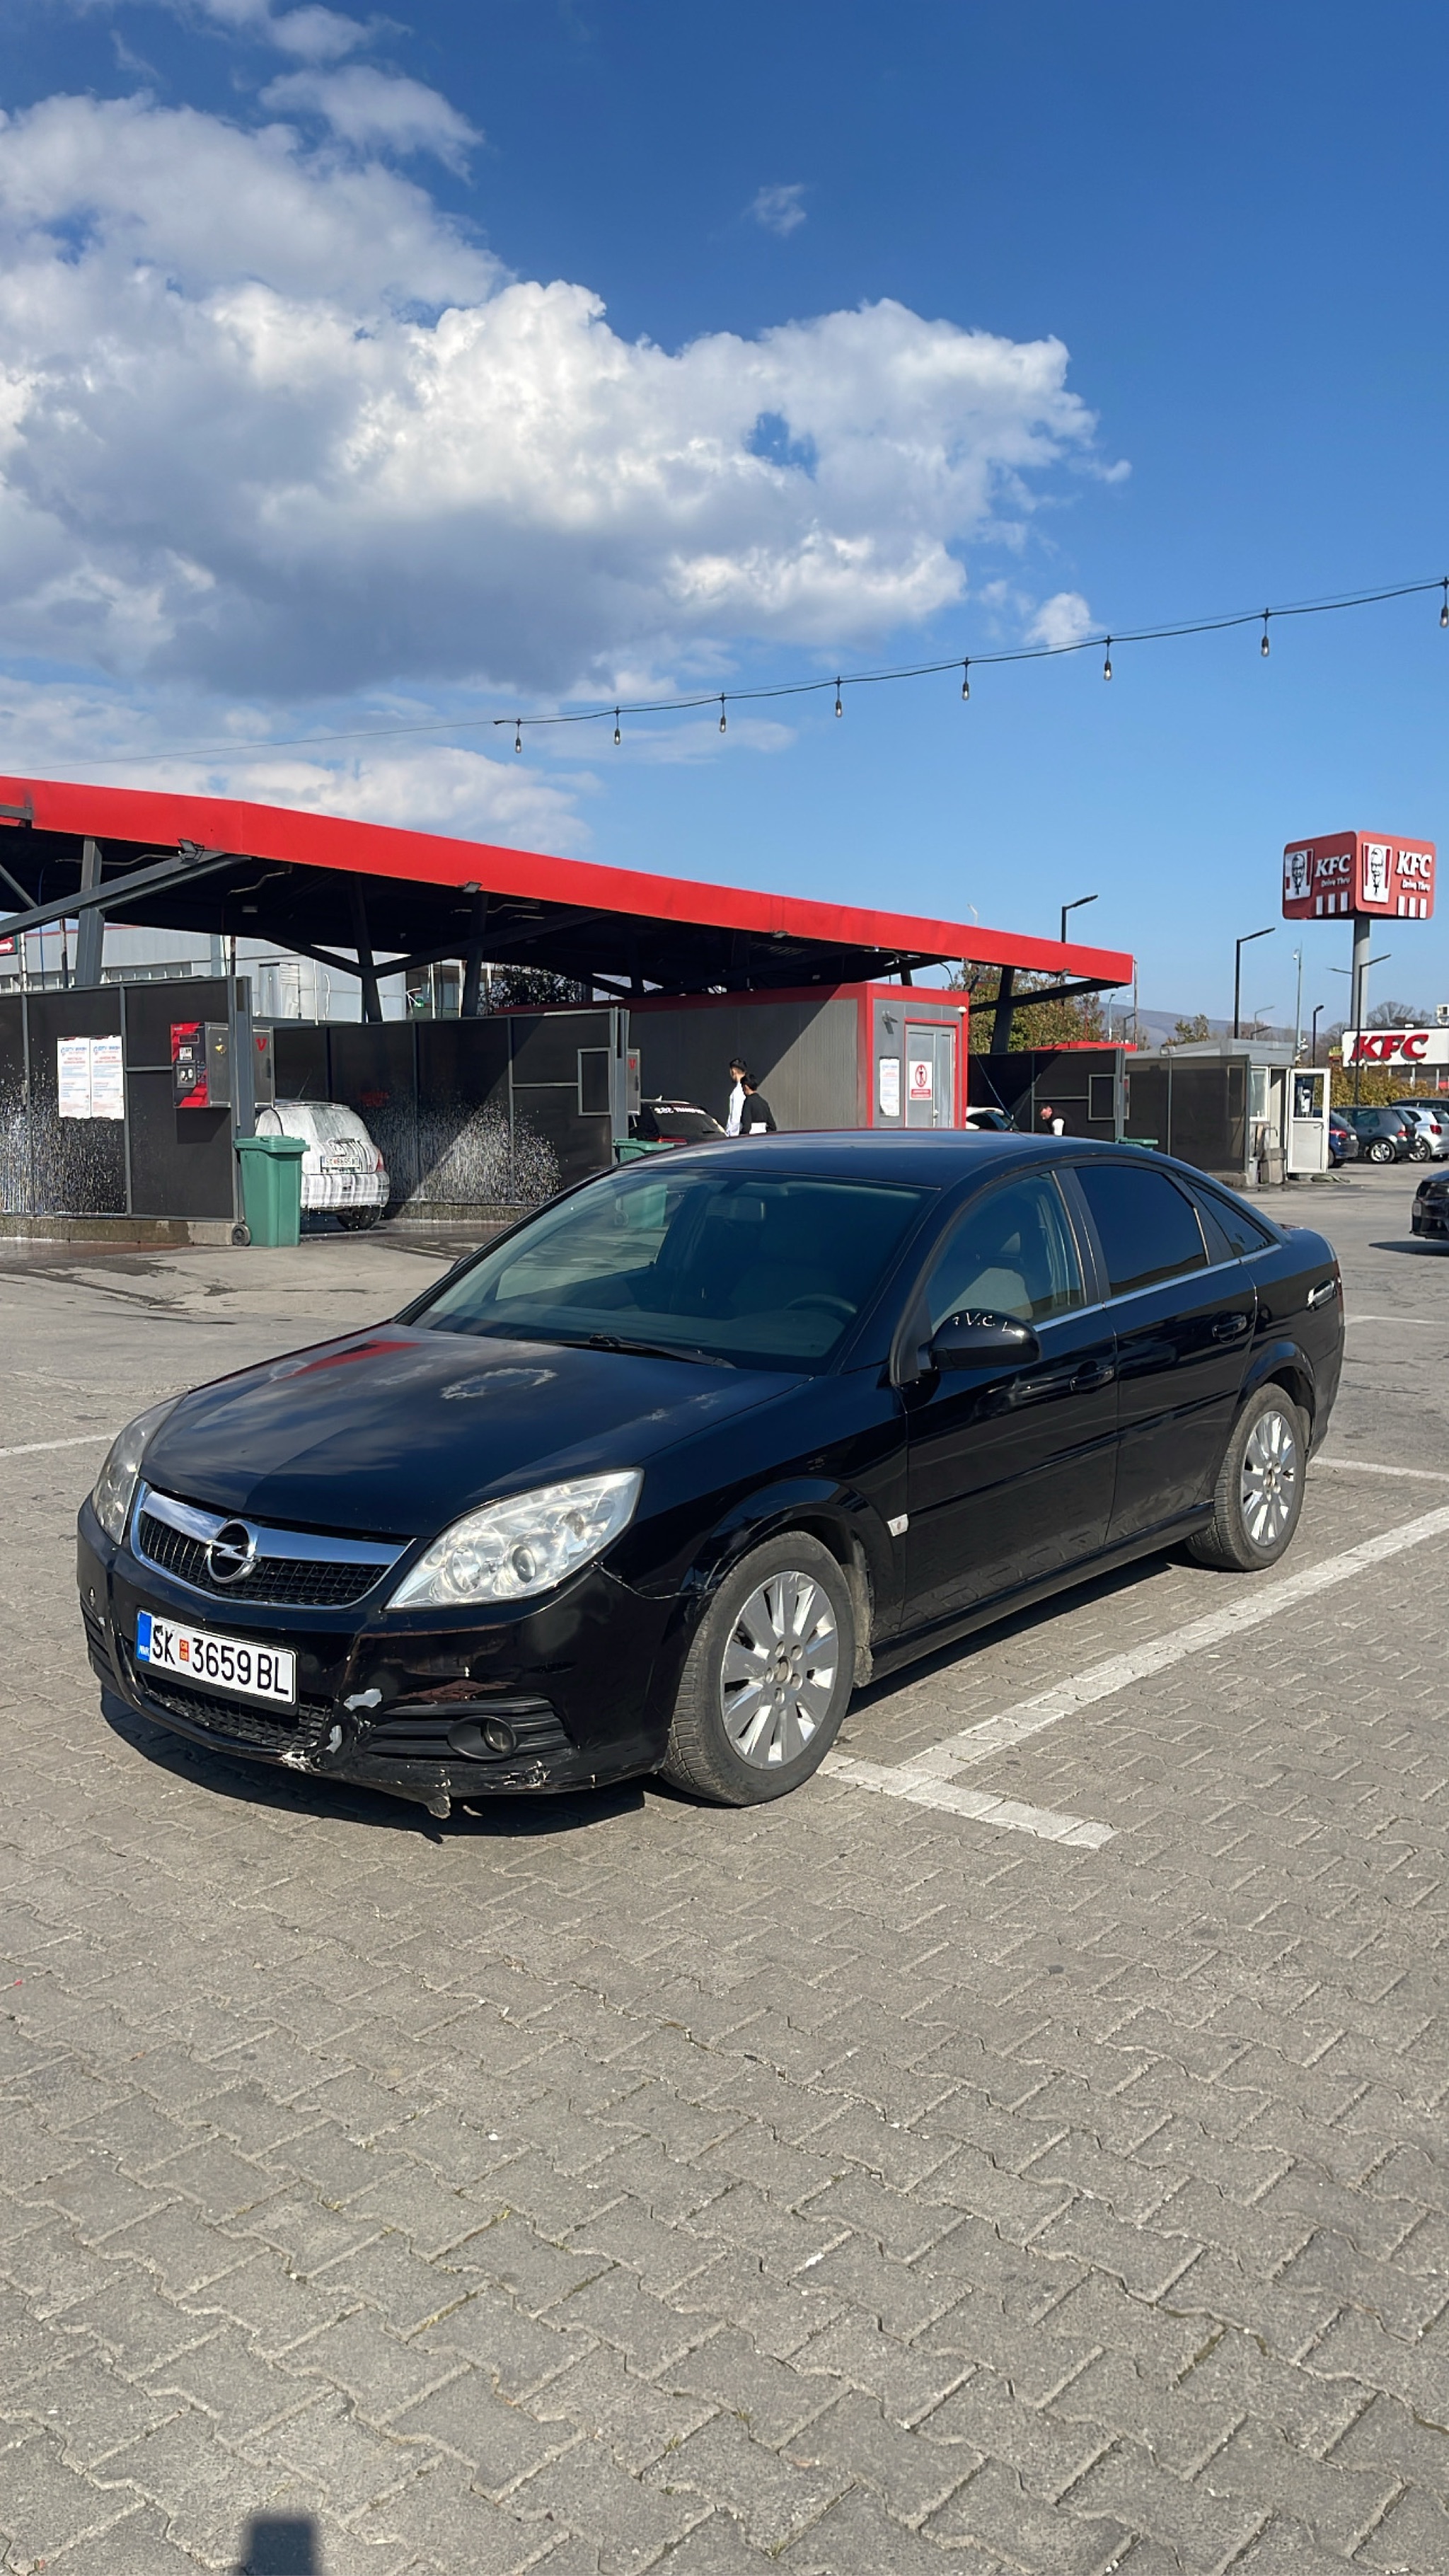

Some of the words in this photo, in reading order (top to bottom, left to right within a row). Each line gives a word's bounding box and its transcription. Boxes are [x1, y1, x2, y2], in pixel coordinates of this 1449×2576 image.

[1315, 854, 1351, 878] KFC
[1396, 851, 1432, 878] KFC
[1321, 879, 1336, 887] Drive
[1337, 876, 1351, 885] Thru
[1402, 880, 1417, 890] Drive
[1418, 880, 1431, 892] Thru
[1351, 1034, 1429, 1061] KFC
[152, 1625, 175, 1665] SK
[192, 1637, 251, 1685] 3659
[257, 1653, 289, 1695] BL
